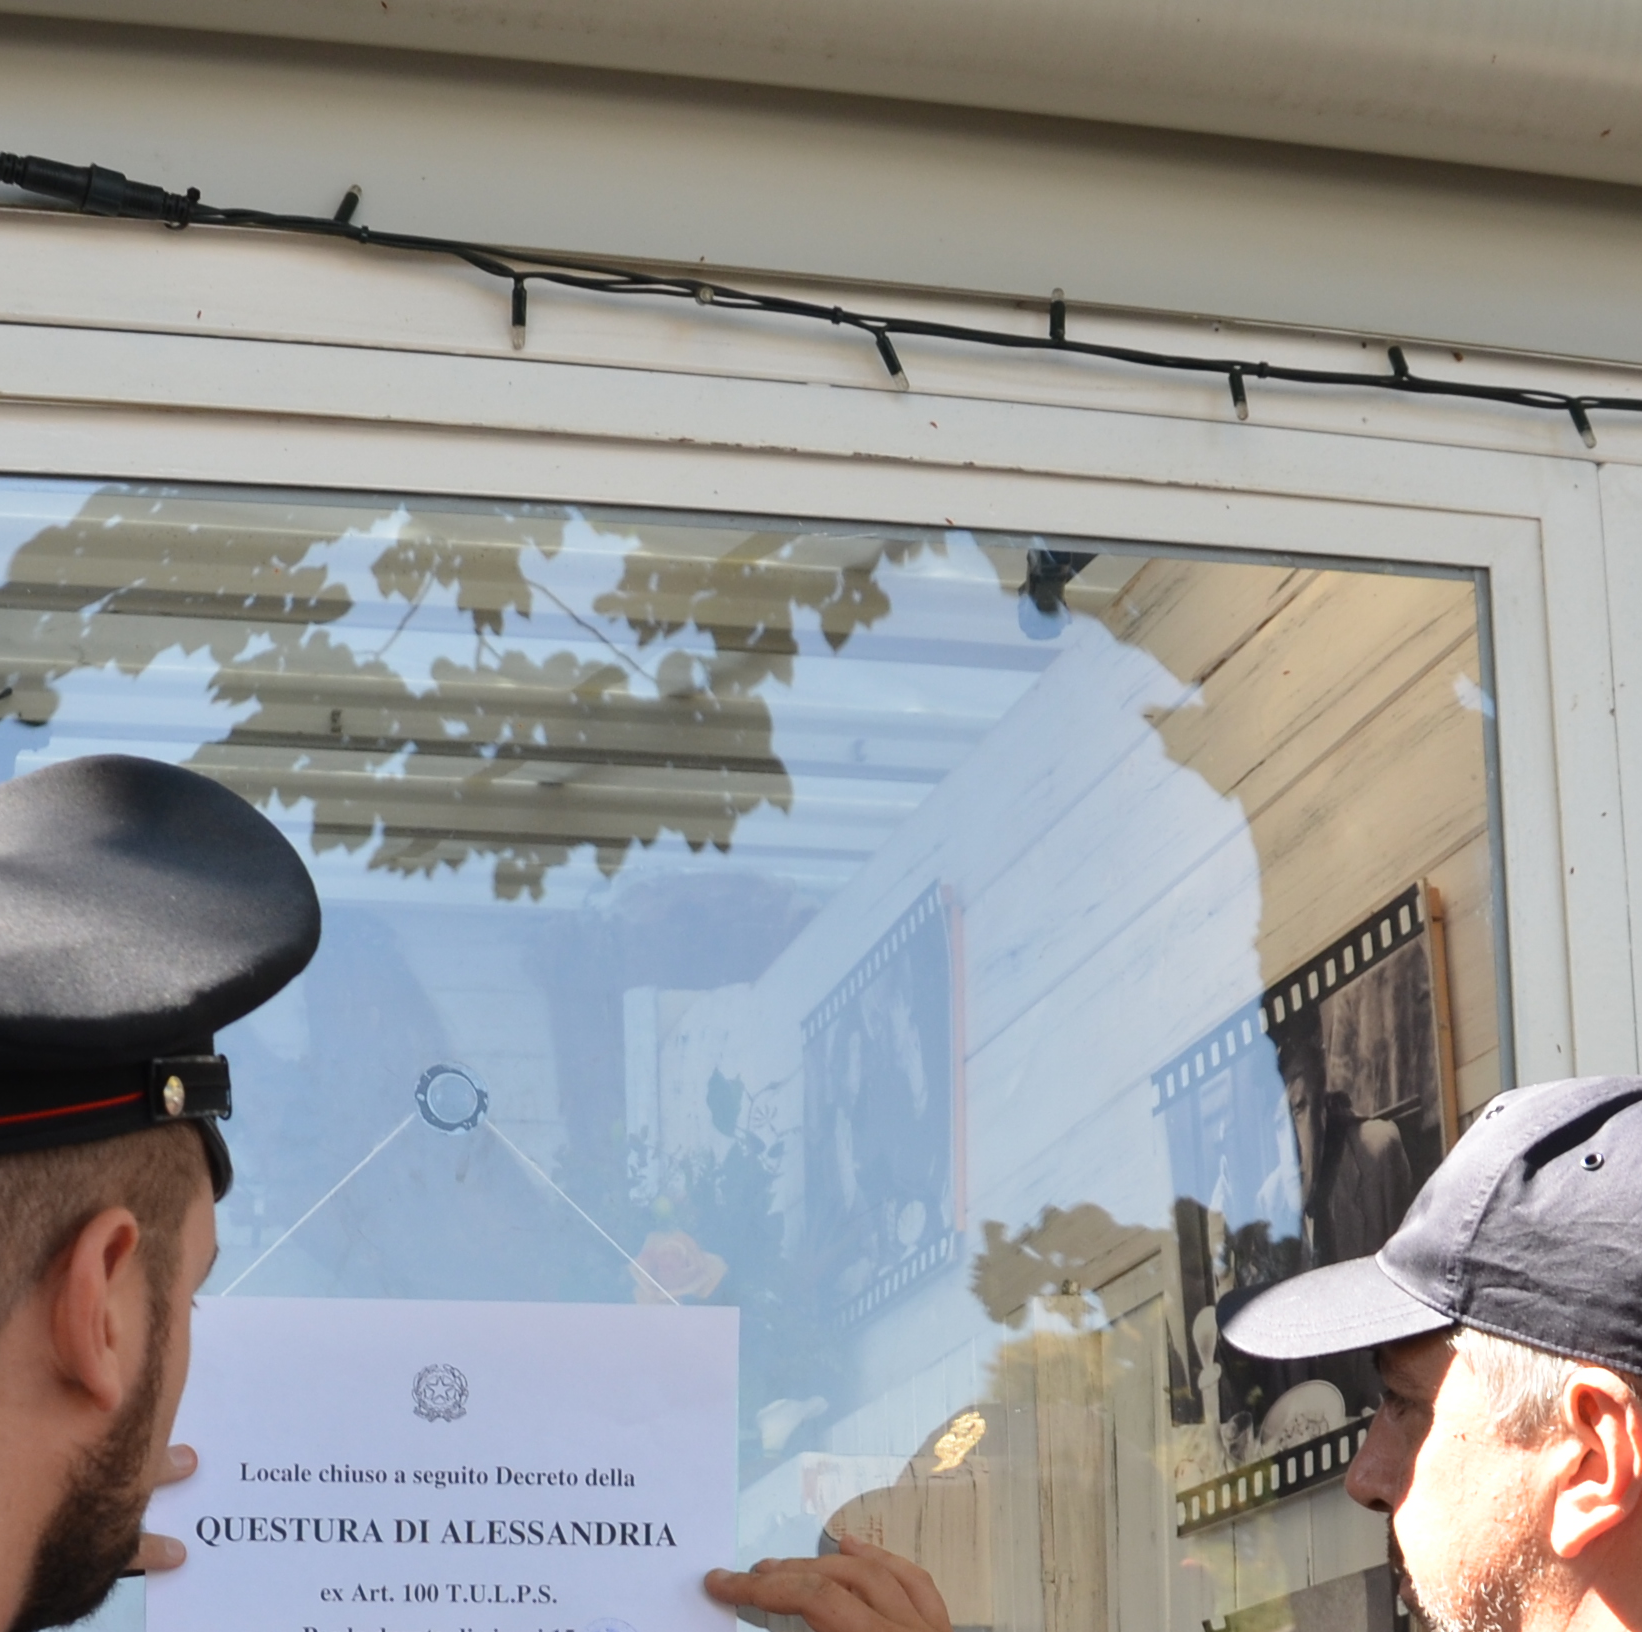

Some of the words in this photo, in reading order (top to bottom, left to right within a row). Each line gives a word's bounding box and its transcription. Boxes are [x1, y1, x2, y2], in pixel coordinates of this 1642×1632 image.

[240, 1462, 312, 1483] Locale
[318, 1463, 388, 1484] chiuso
[393, 1469, 407, 1485] a
[412, 1465, 489, 1490] seguito
[495, 1465, 579, 1487] Decreto
[584, 1467, 636, 1488] della
[195, 1515, 384, 1548] QUESTURA
[393, 1518, 430, 1544] DI
[440, 1518, 678, 1548] ALESSANDRIA
[320, 1587, 344, 1602] ex
[351, 1582, 395, 1603] Art.
[403, 1583, 440, 1604] 100
[445, 1583, 558, 1604] T.U.L.P.S.
